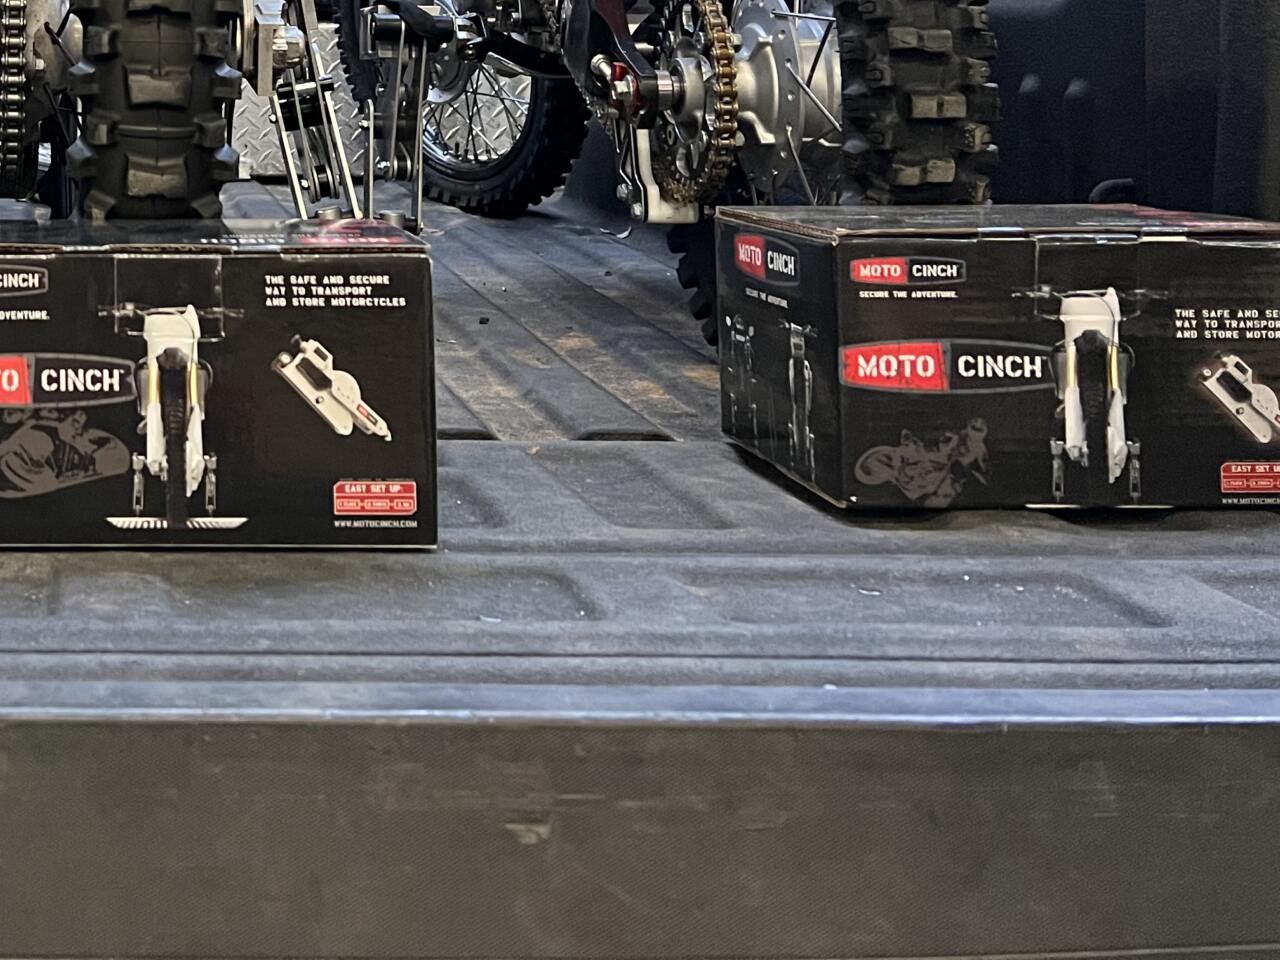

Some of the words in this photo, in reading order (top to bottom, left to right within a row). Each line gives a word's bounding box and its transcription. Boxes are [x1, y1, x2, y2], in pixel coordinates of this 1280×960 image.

[767, 250, 795, 276] CINCH
[860, 264, 901, 277] MOTO
[912, 264, 958, 277] CINCH
[264, 275, 285, 284] THE
[289, 275, 317, 284] SAFE
[322, 275, 344, 284] AND
[349, 275, 390, 284] SECURE
[265, 286, 286, 296] WAY
[292, 286, 306, 296] TO
[311, 286, 372, 296] TRANSPORT
[893, 290, 907, 298] THE
[265, 297, 287, 307] AND
[292, 297, 326, 307] STORE
[330, 297, 407, 307] MOTORCYCLES
[1174, 309, 1196, 318] THE
[1202, 309, 1231, 318] SAFE
[1237, 309, 1259, 318] AND
[1265, 309, 1280, 318] SE
[1175, 320, 1197, 329] WAY
[1204, 320, 1218, 329] TO
[1176, 330, 1198, 339] AND
[1204, 330, 1240, 339] STORE
[858, 354, 935, 378] MOTO
[957, 354, 1043, 378] CINCH
[40, 368, 121, 392] CINCH
[333, 519, 418, 528] WWW.MOTOCINCH.COM
